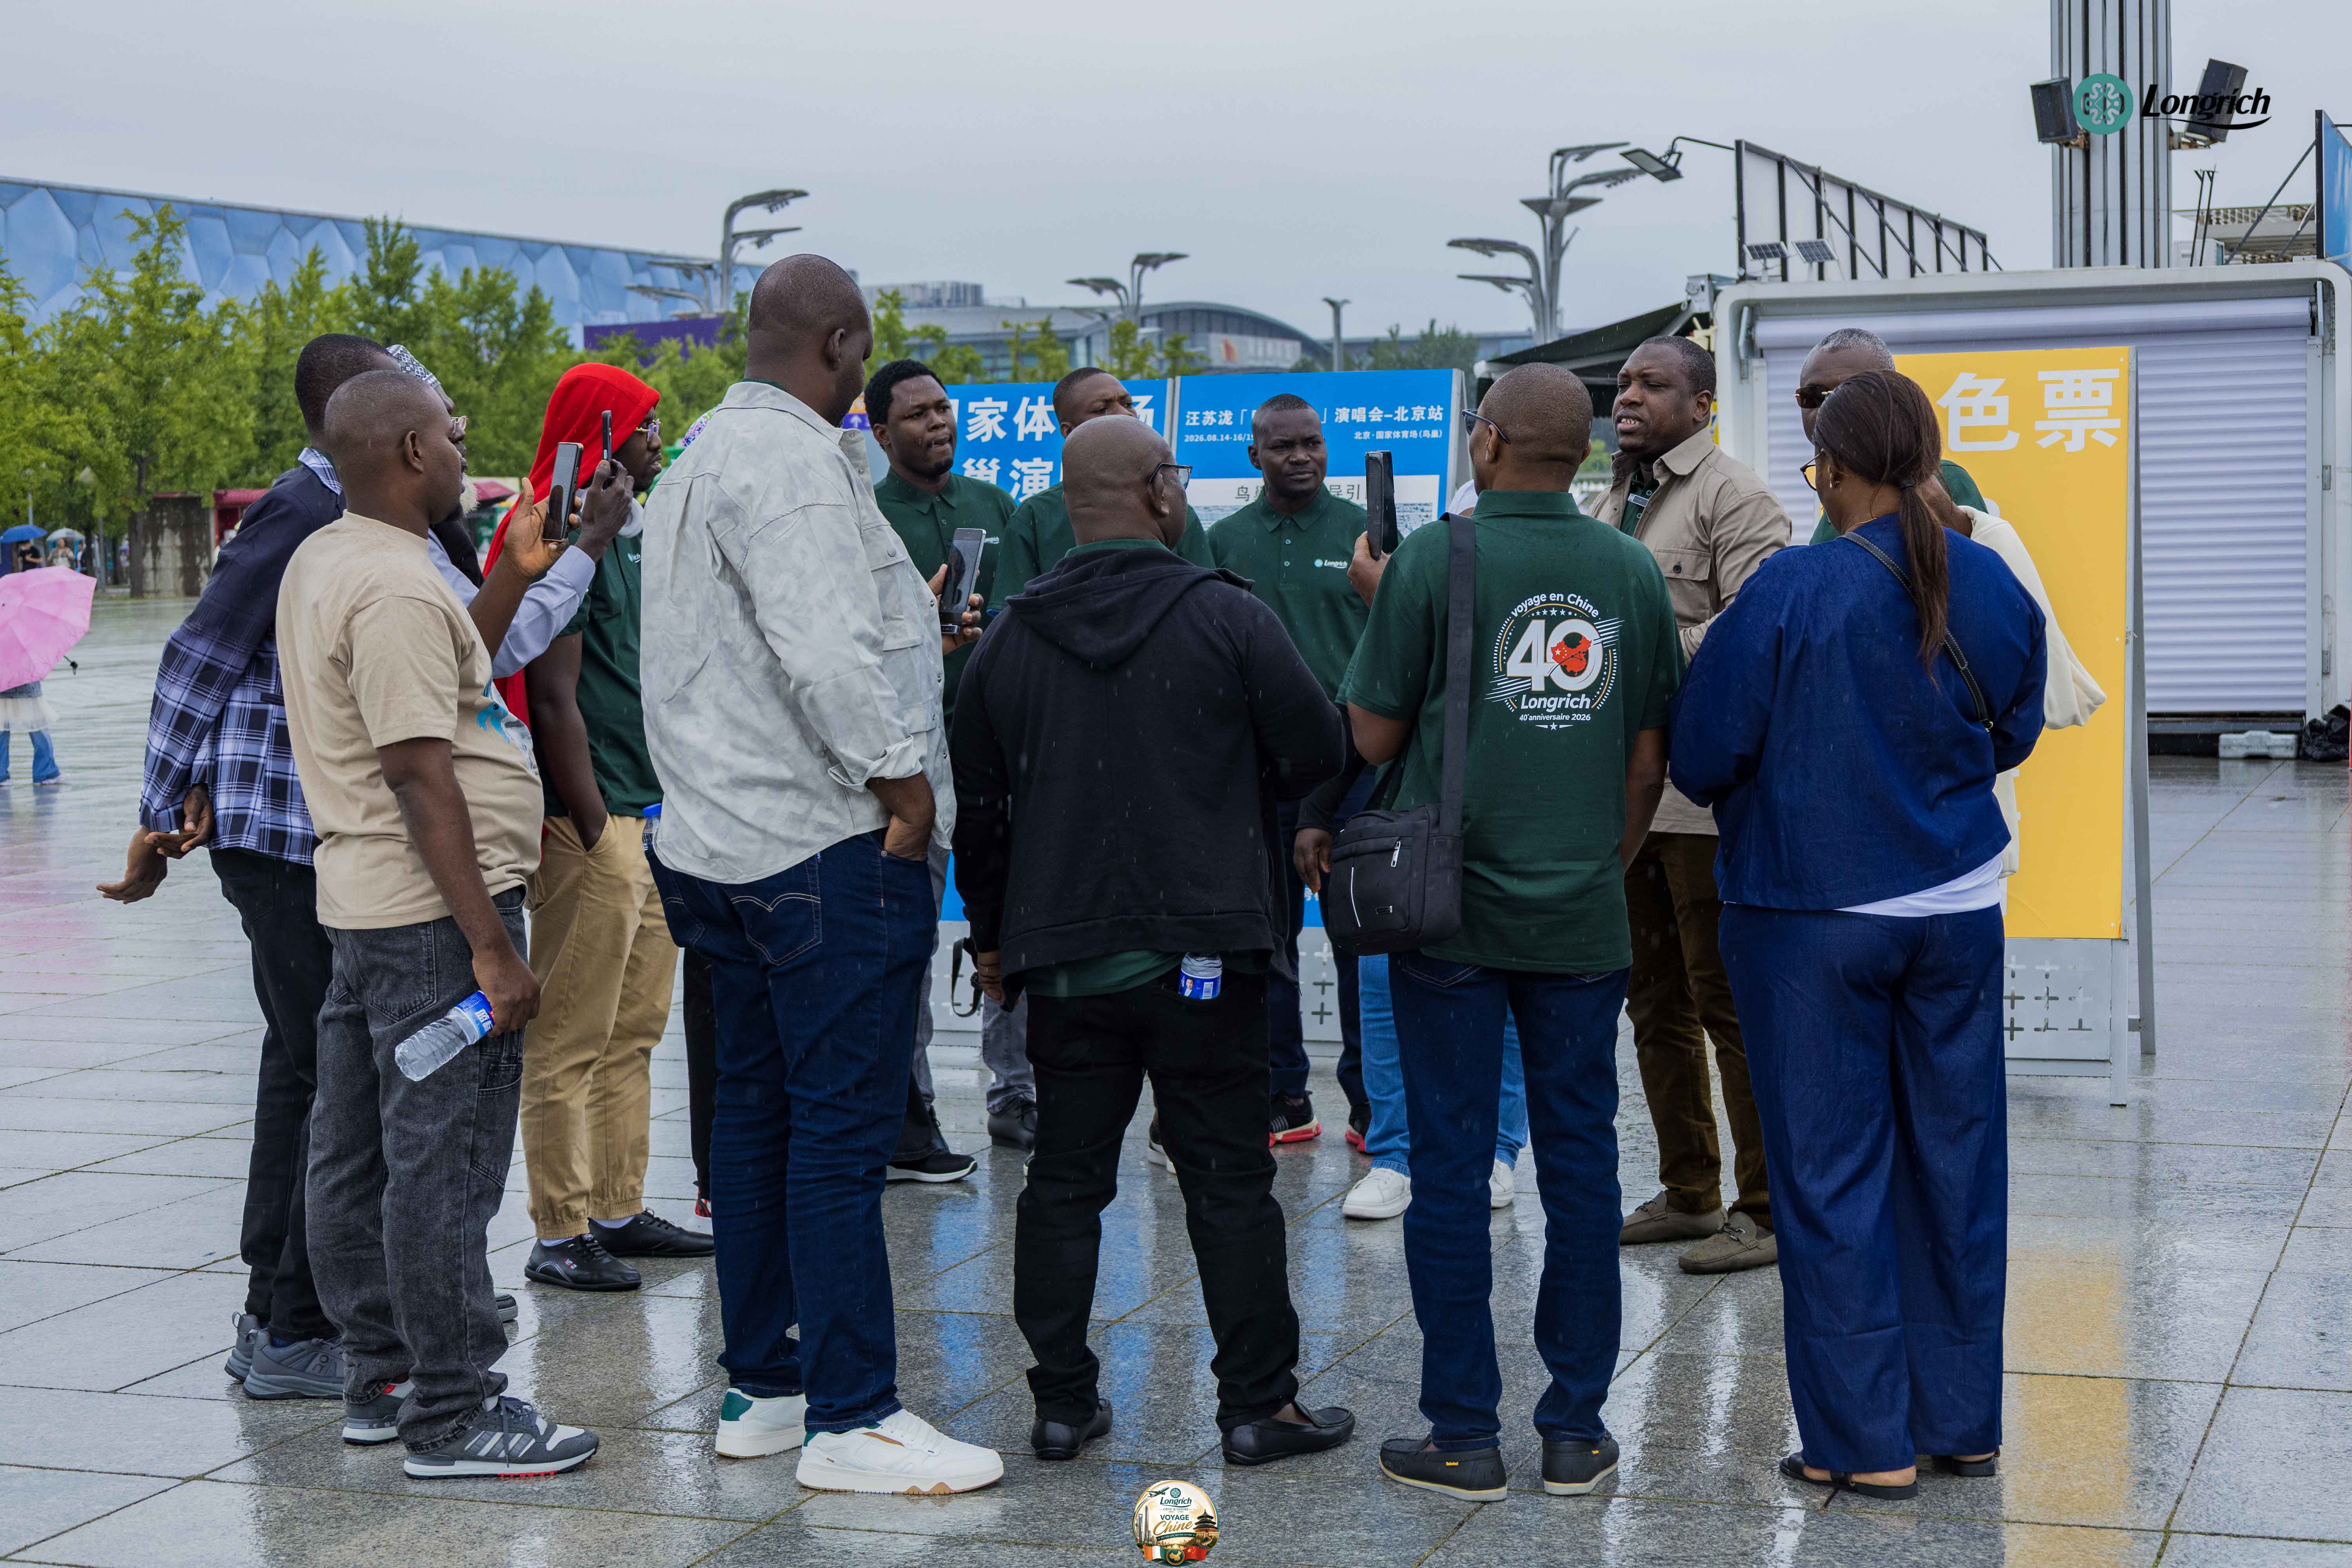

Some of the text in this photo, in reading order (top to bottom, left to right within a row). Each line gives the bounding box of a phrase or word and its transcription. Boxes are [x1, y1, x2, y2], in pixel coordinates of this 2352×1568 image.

[1936, 368, 2121, 452] 色票
[1511, 593, 1599, 617] voyage en Chine
[1506, 619, 1603, 691] 40
[1521, 693, 1590, 712] Longrich
